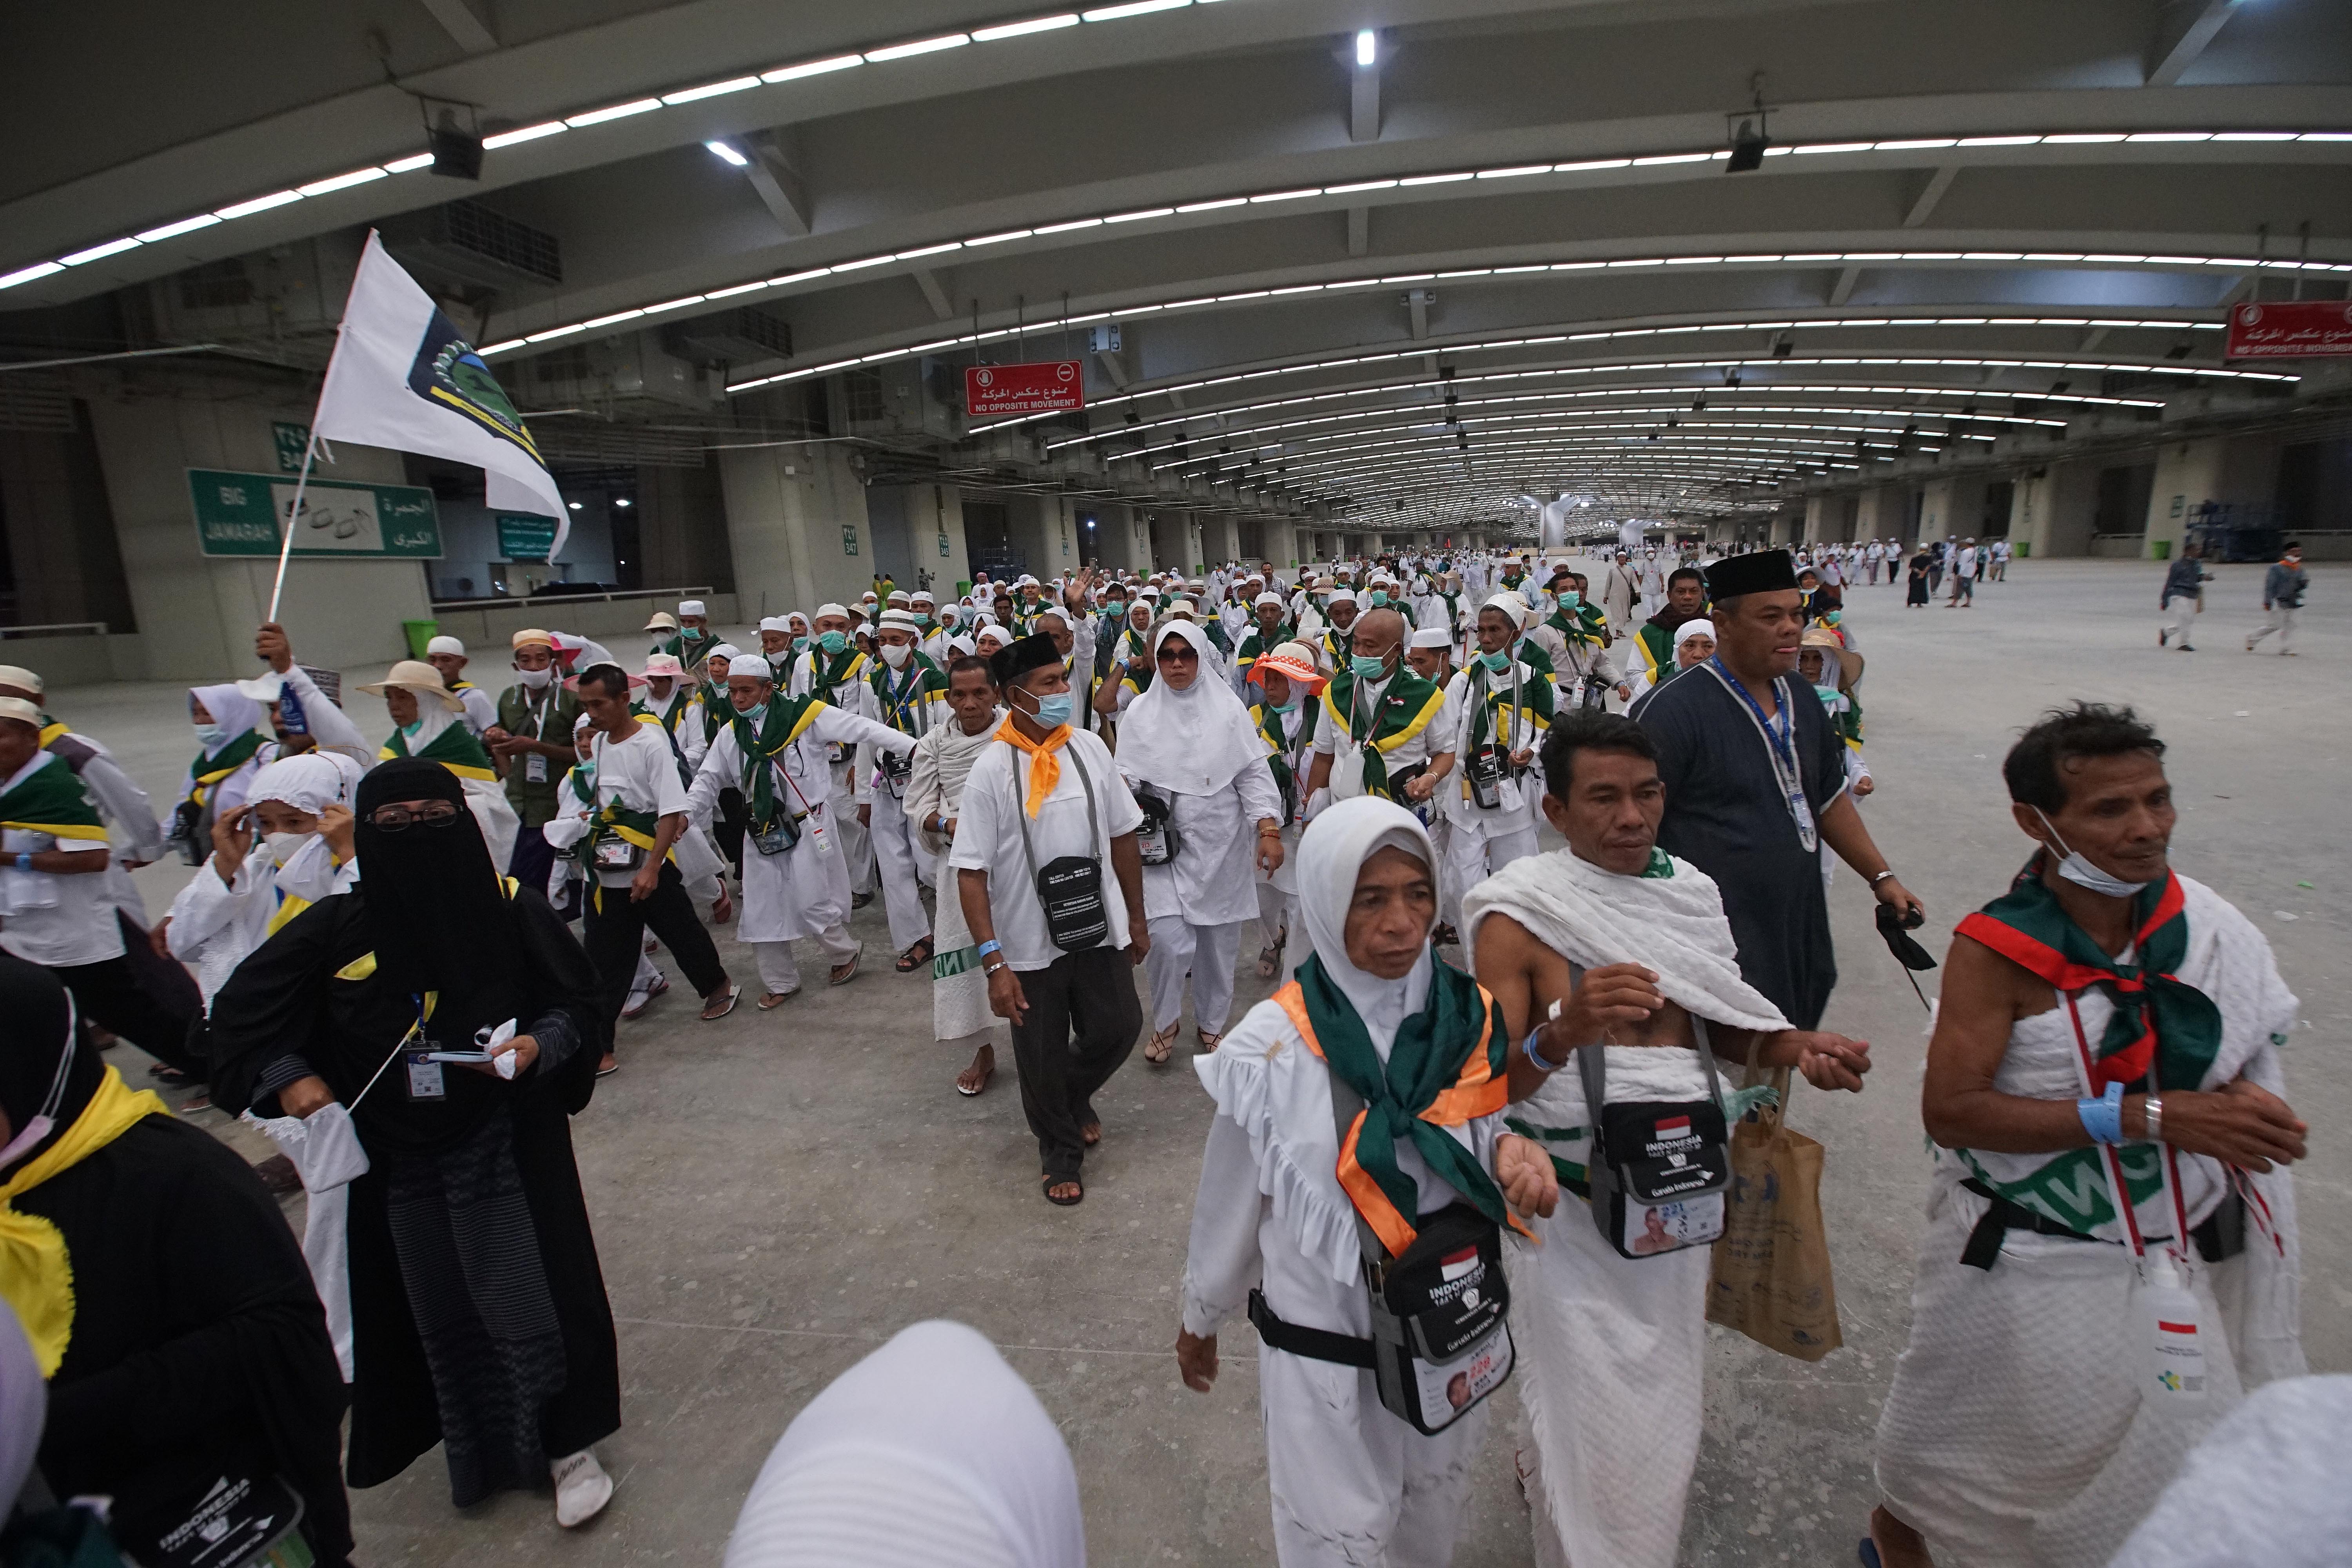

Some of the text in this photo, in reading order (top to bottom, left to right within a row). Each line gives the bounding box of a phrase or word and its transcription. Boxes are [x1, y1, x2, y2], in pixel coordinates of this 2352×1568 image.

[982, 387, 1068, 400] ممنوع عكس الحركة
[989, 401, 1028, 411] OPPOSITE
[1031, 399, 1076, 408] MOVEMENT
[219, 486, 247, 506] BIG
[383, 497, 433, 517] الجمرة
[206, 522, 272, 541] JAMARAH
[393, 531, 433, 546] الكبرى
[846, 543, 857, 554] 347
[940, 547, 949, 555] 345
